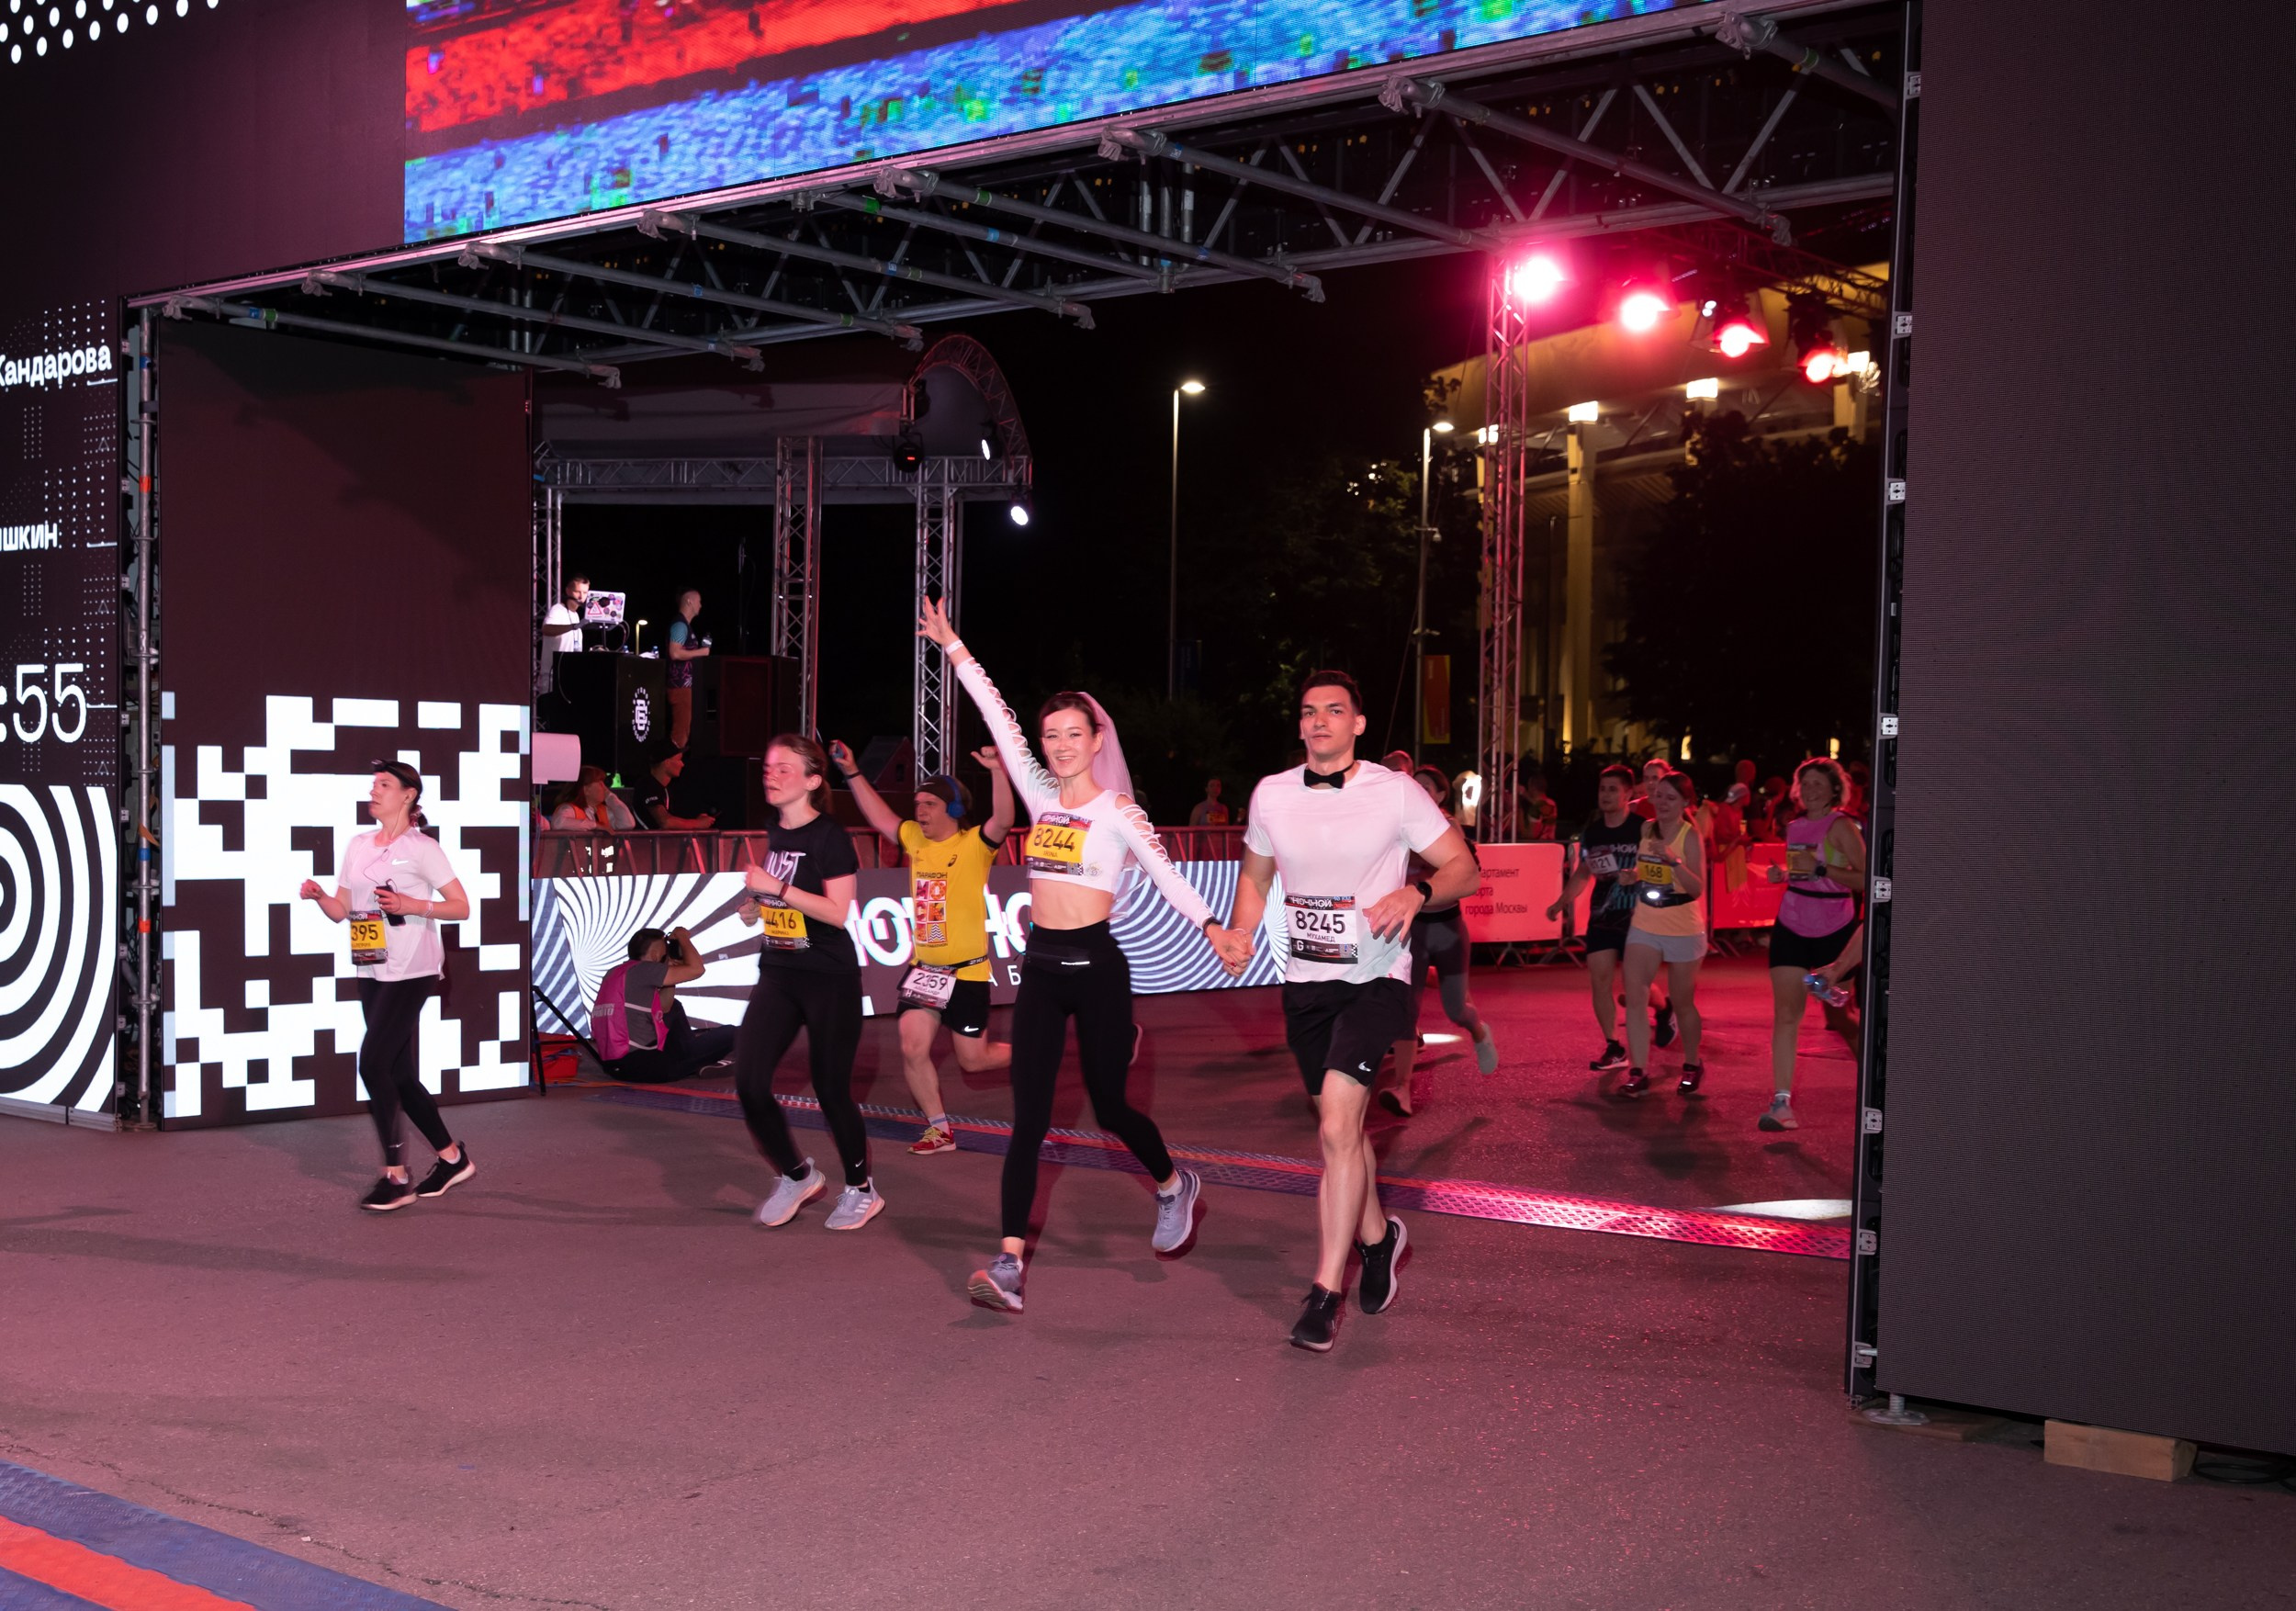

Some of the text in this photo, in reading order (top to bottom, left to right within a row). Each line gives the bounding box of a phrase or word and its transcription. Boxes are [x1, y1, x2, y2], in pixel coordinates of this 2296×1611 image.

[0, 522, 58, 551] шкин
[1034, 828, 1075, 852] 8244
[1481, 868, 1520, 881] артамент
[1645, 864, 1662, 878] 168
[1476, 886, 1494, 900] орта
[1466, 902, 1528, 917] города Москвы
[765, 911, 797, 929] 4416
[1295, 910, 1346, 934] 8245
[1307, 932, 1336, 942] МУХАМЕД
[1297, 940, 1304, 951] G
